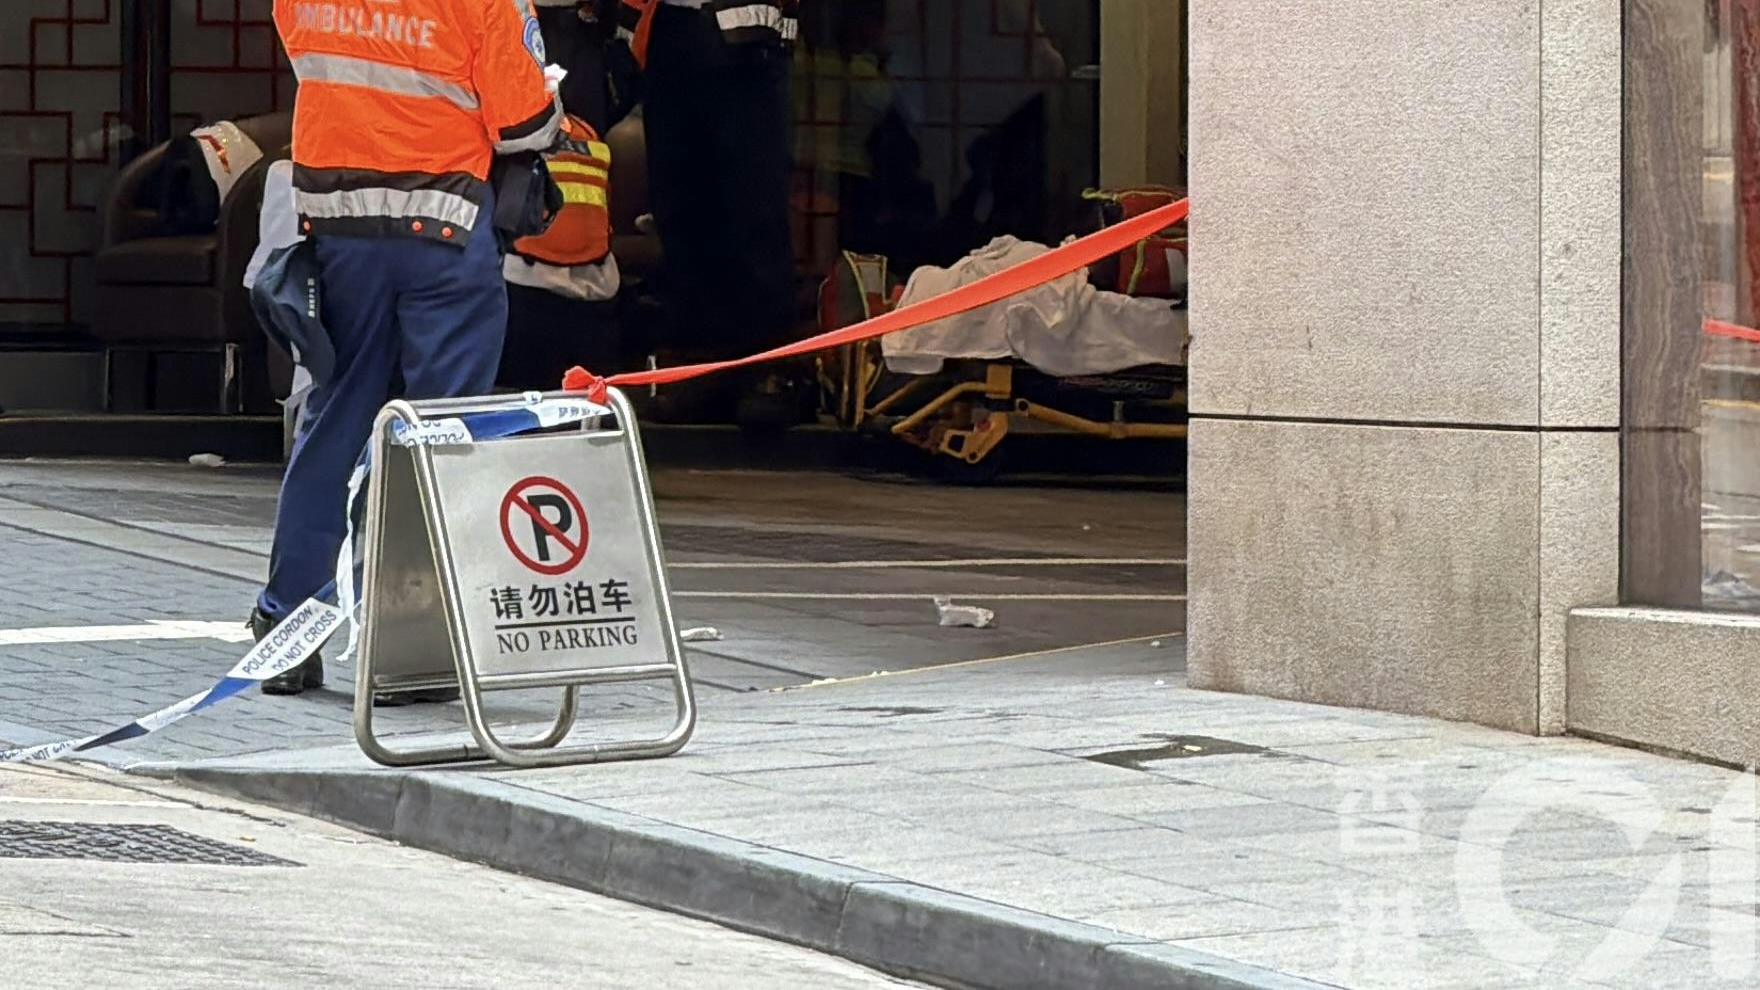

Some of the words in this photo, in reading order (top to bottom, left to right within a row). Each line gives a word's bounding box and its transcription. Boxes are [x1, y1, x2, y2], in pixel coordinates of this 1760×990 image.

[490, 578, 632, 620] 请勿泊车
[242, 642, 276, 675] POLICE
[273, 605, 313, 648] CORDON
[285, 640, 306, 661] NOT
[303, 610, 337, 643] CROSS
[497, 631, 529, 654] NO
[538, 625, 638, 651] PARKING
